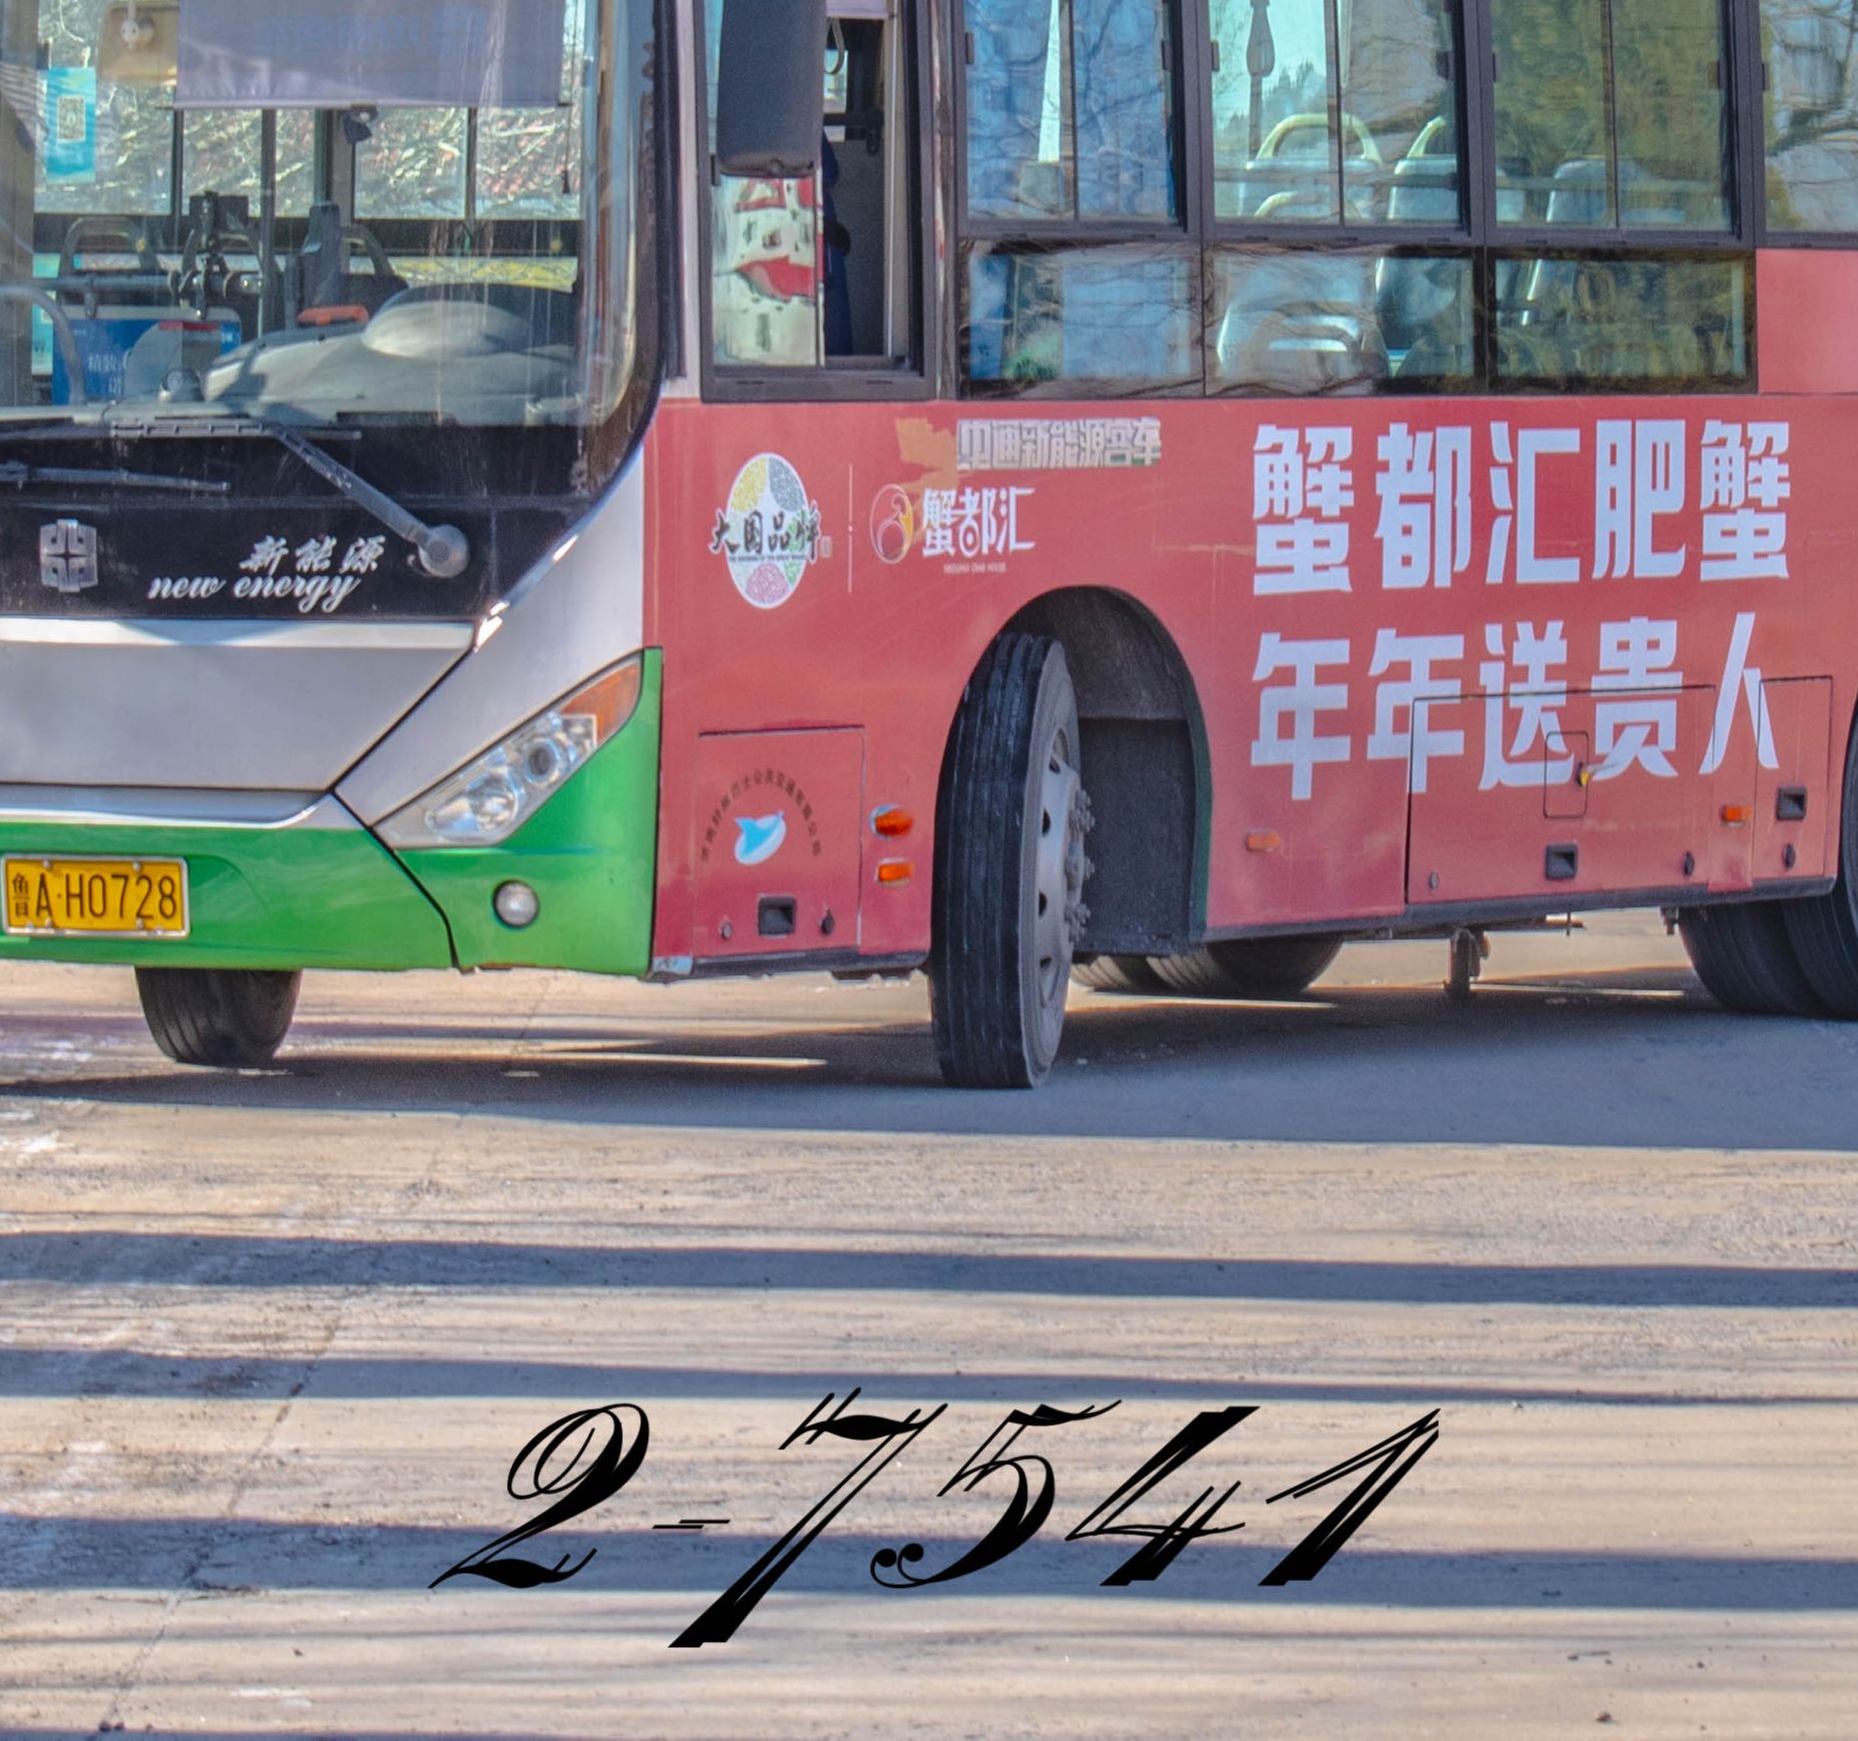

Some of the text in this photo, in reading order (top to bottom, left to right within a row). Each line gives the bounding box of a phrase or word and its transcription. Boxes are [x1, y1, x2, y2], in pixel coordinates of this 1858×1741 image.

[710, 500, 821, 563] 大国品牌
[922, 486, 1036, 558] 蟹都汇
[1252, 419, 1791, 596] 蟹都汇肥蟹
[239, 535, 386, 575] 新能源
[147, 573, 362, 614] new energy
[1250, 611, 1780, 801] 年年送贵人
